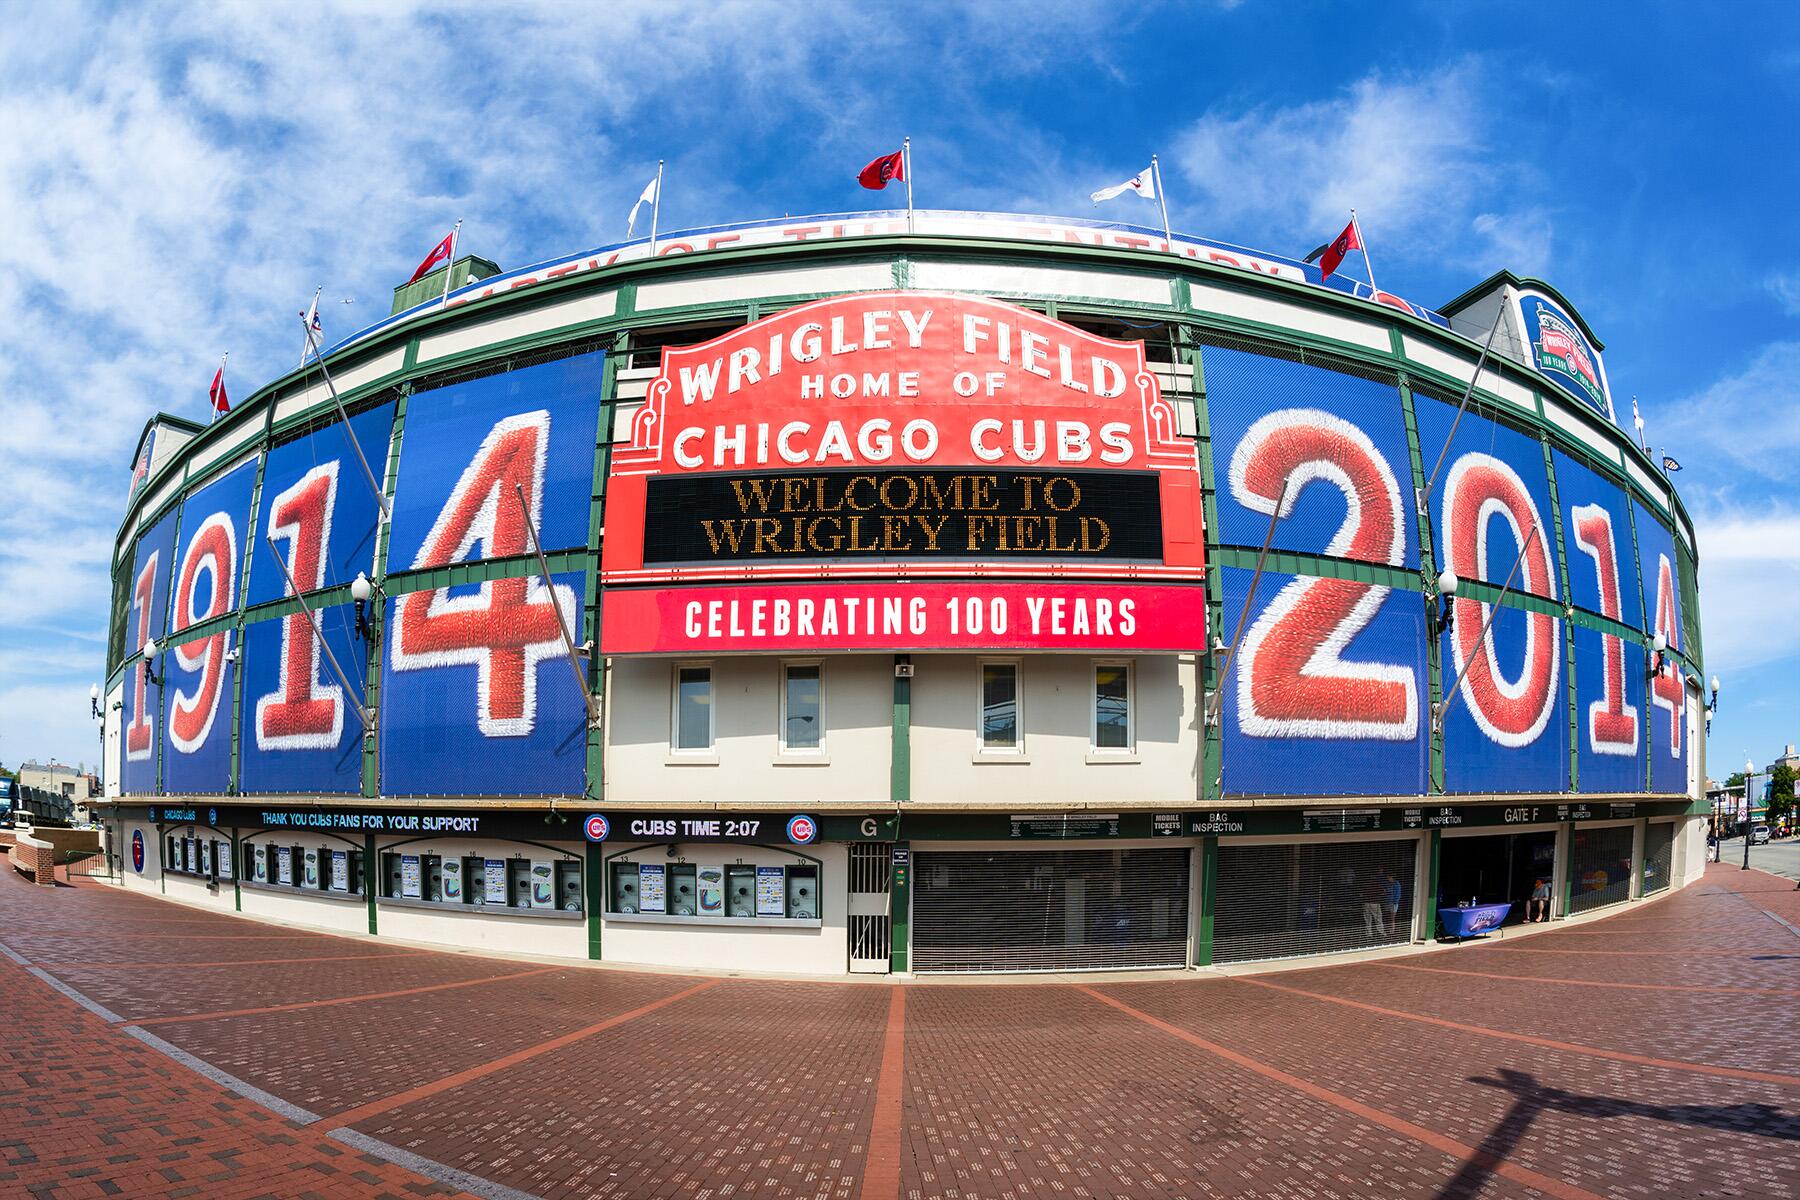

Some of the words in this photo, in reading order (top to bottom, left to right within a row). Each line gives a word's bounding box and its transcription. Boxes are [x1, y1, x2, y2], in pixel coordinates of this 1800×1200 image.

[678, 309, 934, 405] WRIGLEY
[962, 313, 1127, 399] FIELD
[801, 372, 920, 399] HOME
[953, 372, 1006, 398] OF
[672, 418, 940, 469] CHICAGO
[970, 418, 1134, 467] CUBS
[730, 475, 1000, 513] WELCOME
[1013, 476, 1081, 511] TO
[701, 515, 949, 554] WRIGLEY
[963, 515, 1111, 552] FIELD
[126, 408, 577, 763] 1914
[1228, 406, 1686, 760] 2014
[685, 596, 928, 639] CELEBRATING
[946, 596, 1008, 636] 100
[1028, 597, 1137, 637] YEARS
[1155, 814, 1180, 822] MOBILE
[1209, 813, 1228, 822] BAG
[1429, 815, 1462, 825] INSPECTION
[1440, 807, 1453, 816] BAG
[1504, 808, 1529, 822] GATE
[1532, 807, 1539, 821] F
[262, 812, 288, 826] THANK
[290, 813, 307, 826] YOU
[309, 813, 332, 827] CUBS
[334, 814, 360, 828] FANS
[362, 815, 384, 829] FOR
[387, 815, 419, 830] YOUR
[422, 816, 480, 832] SUPPORT
[631, 820, 677, 836] CUBS
[681, 820, 721, 836] TIME
[725, 821, 760, 837] 2:07
[860, 818, 878, 837] G
[1192, 822, 1243, 832] INSPECTION
[798, 858, 806, 866] 10
